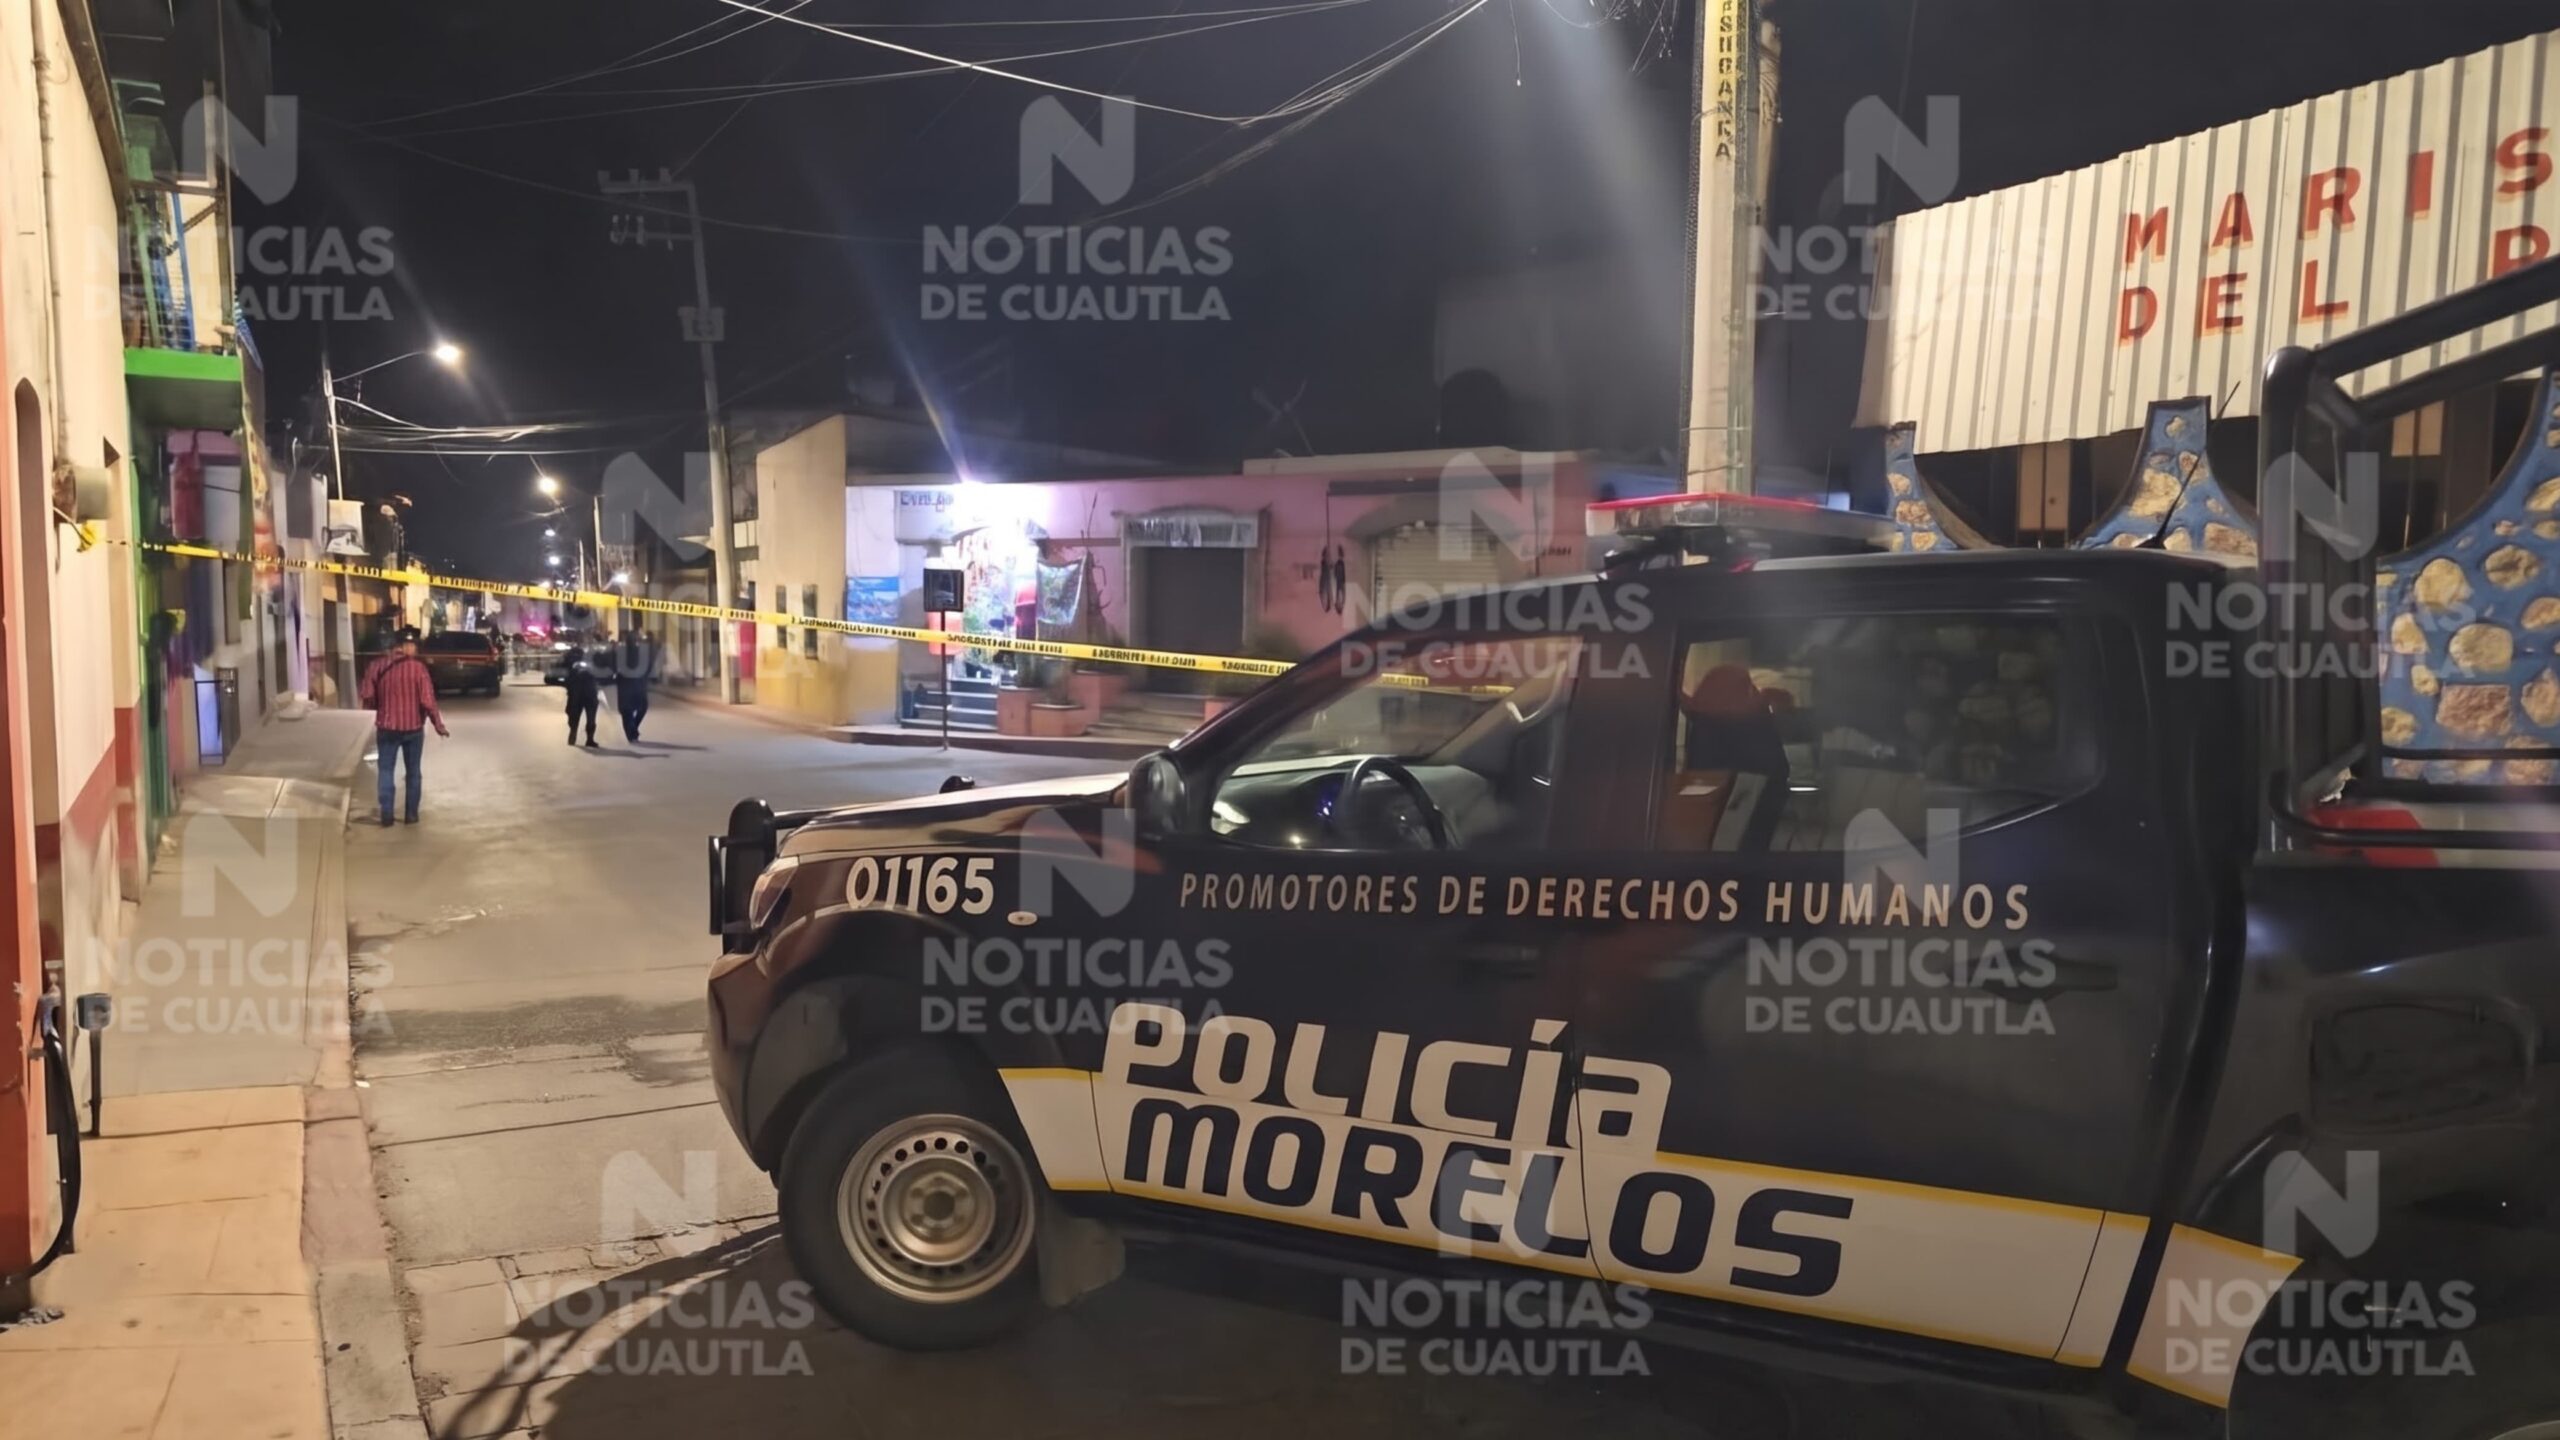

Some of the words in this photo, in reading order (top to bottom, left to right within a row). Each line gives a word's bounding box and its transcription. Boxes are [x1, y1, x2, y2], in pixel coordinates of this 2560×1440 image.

[2117, 261, 2349, 346] DEL
[846, 856, 994, 914] 01165
[1179, 872, 1418, 914] PROMOTORES
[1438, 876, 1486, 915] DE
[1506, 877, 1739, 922] DERECHOS
[1765, 881, 2029, 930] HUMANOS
[1123, 1097, 1855, 1298] MORELOS
